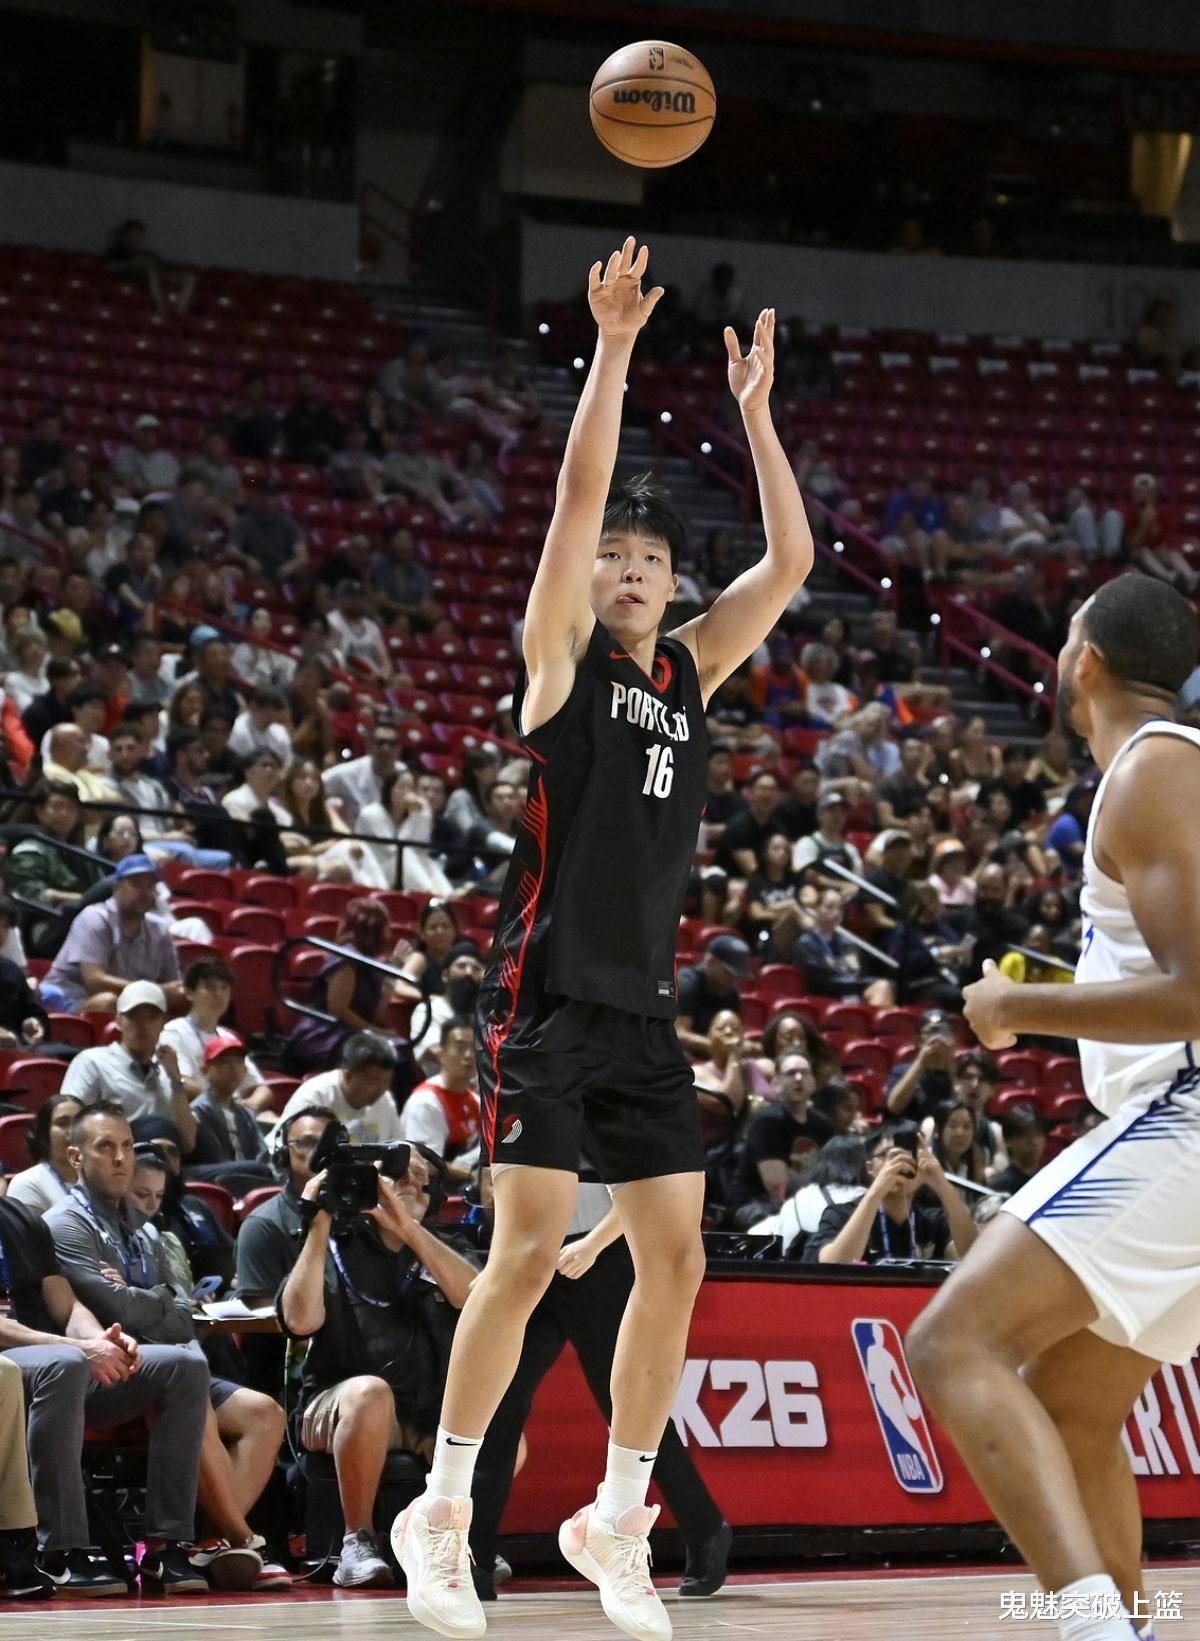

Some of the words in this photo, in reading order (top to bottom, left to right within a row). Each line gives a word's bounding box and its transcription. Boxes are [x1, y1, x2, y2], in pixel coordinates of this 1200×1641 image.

[612, 88, 697, 114] Wilson
[641, 743, 675, 799] 16
[896, 1453, 926, 1481] NBA
